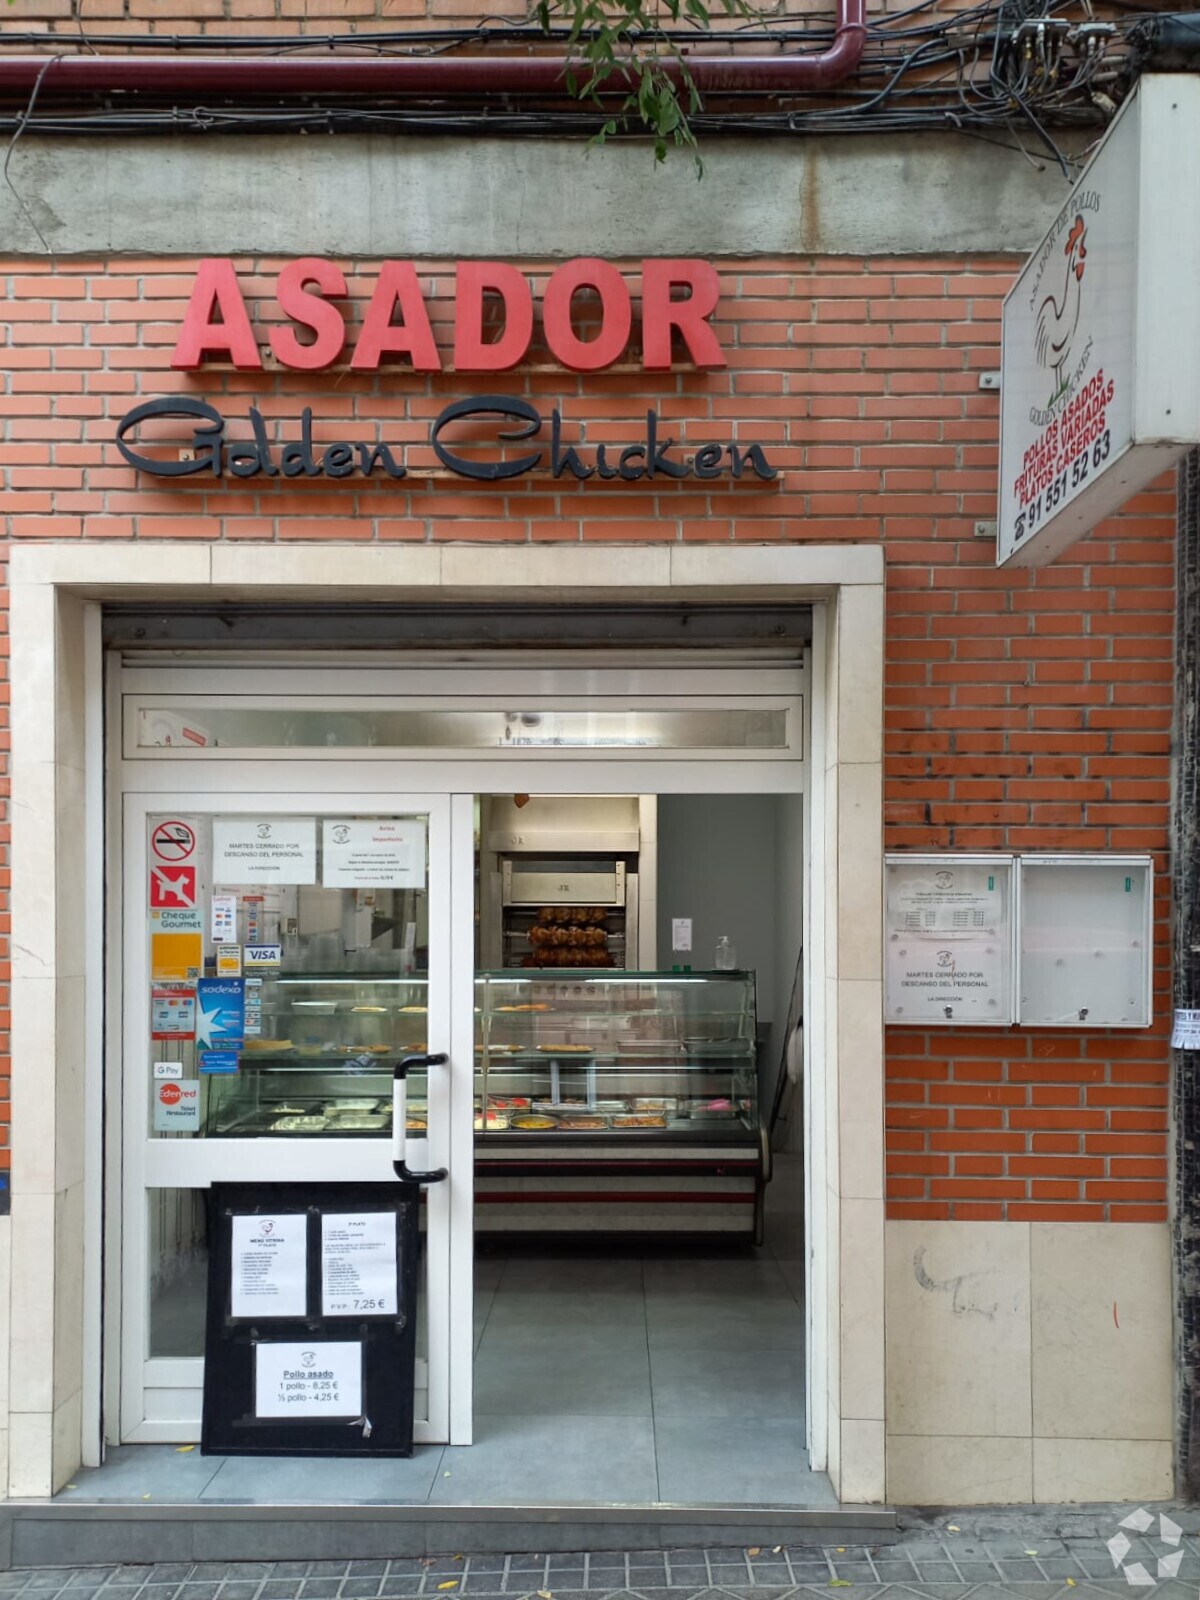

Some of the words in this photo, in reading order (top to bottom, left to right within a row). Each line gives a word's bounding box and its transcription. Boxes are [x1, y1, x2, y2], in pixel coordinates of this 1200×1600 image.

[1030, 231, 1057, 312] ASADOR
[1056, 213, 1069, 236] DE
[1070, 190, 1101, 217] POLLOS
[170, 257, 728, 374] ASADOR
[1029, 405, 1056, 427] GOLDEN
[1057, 334, 1094, 414] CHICKEN
[1023, 419, 1059, 471] POLLOS
[1061, 367, 1104, 431] ASADOS
[116, 396, 407, 479] Golden
[431, 395, 779, 481] Chicken
[1013, 439, 1059, 498] FRITURAS
[1061, 378, 1114, 449] VARIADAS
[1019, 463, 1054, 510] PLATOS
[1056, 410, 1106, 475] CASEROS
[1029, 494, 1042, 529] 91
[1045, 470, 1067, 513] 551
[1072, 450, 1089, 488] 52
[1092, 428, 1111, 468] 63
[161, 911, 197, 920] Cheque
[161, 920, 201, 928] Gourmet
[250, 950, 277, 960] VISA
[200, 985, 241, 994] sodexo
[166, 1066, 180, 1075] Pay
[159, 1089, 196, 1098] Edenred
[353, 1299, 376, 1309] 7,25
[378, 1299, 385, 1308] €
[283, 1370, 305, 1378] Pollo
[307, 1370, 334, 1378] asado
[286, 1382, 306, 1391] pollo
[312, 1382, 331, 1390] 8,25
[332, 1381, 339, 1389] €
[287, 1393, 307, 1403] pollo
[314, 1393, 332, 1401] 4,25
[333, 1392, 340, 1401] €
